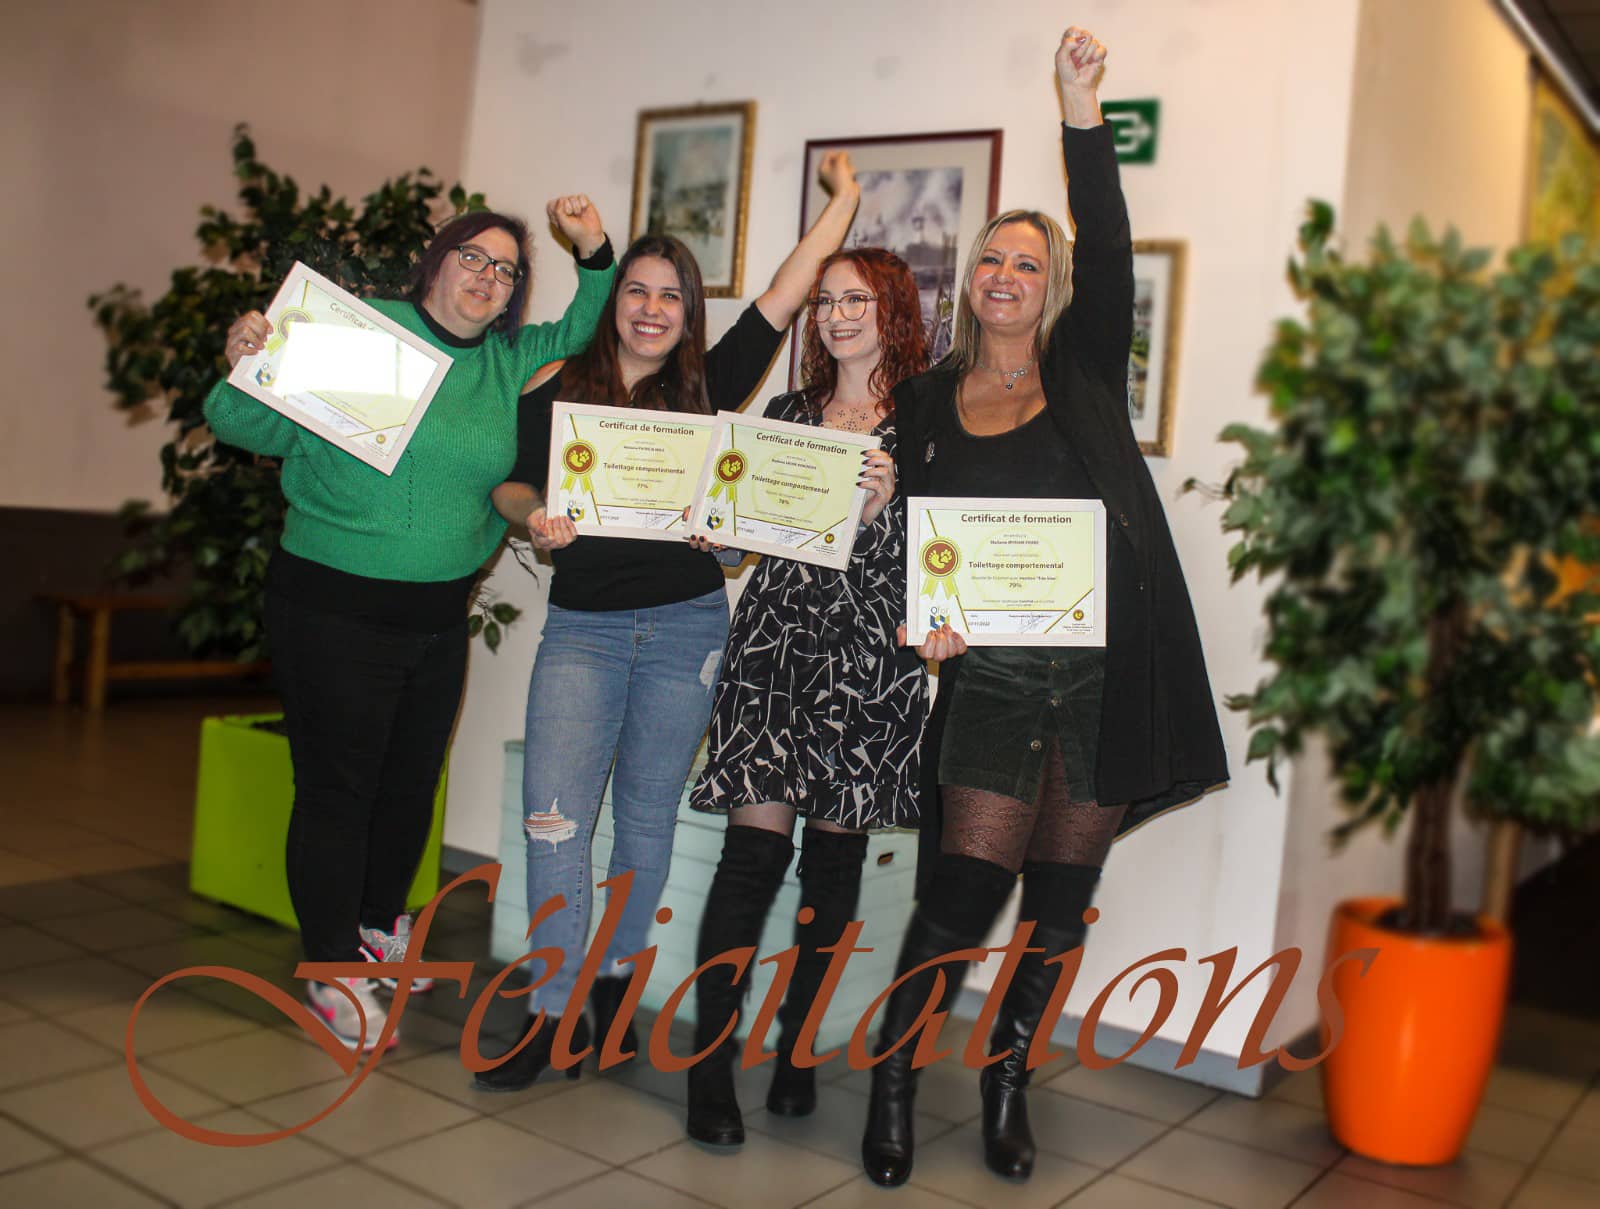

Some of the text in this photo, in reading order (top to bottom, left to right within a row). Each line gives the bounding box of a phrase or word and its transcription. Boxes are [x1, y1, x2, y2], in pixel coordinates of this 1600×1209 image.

[599, 420, 694, 436] Certificat de formation
[756, 432, 848, 455] Certificat de formation
[960, 513, 1072, 525] Certificat de formation
[968, 561, 1064, 571] Toilettage comportemental
